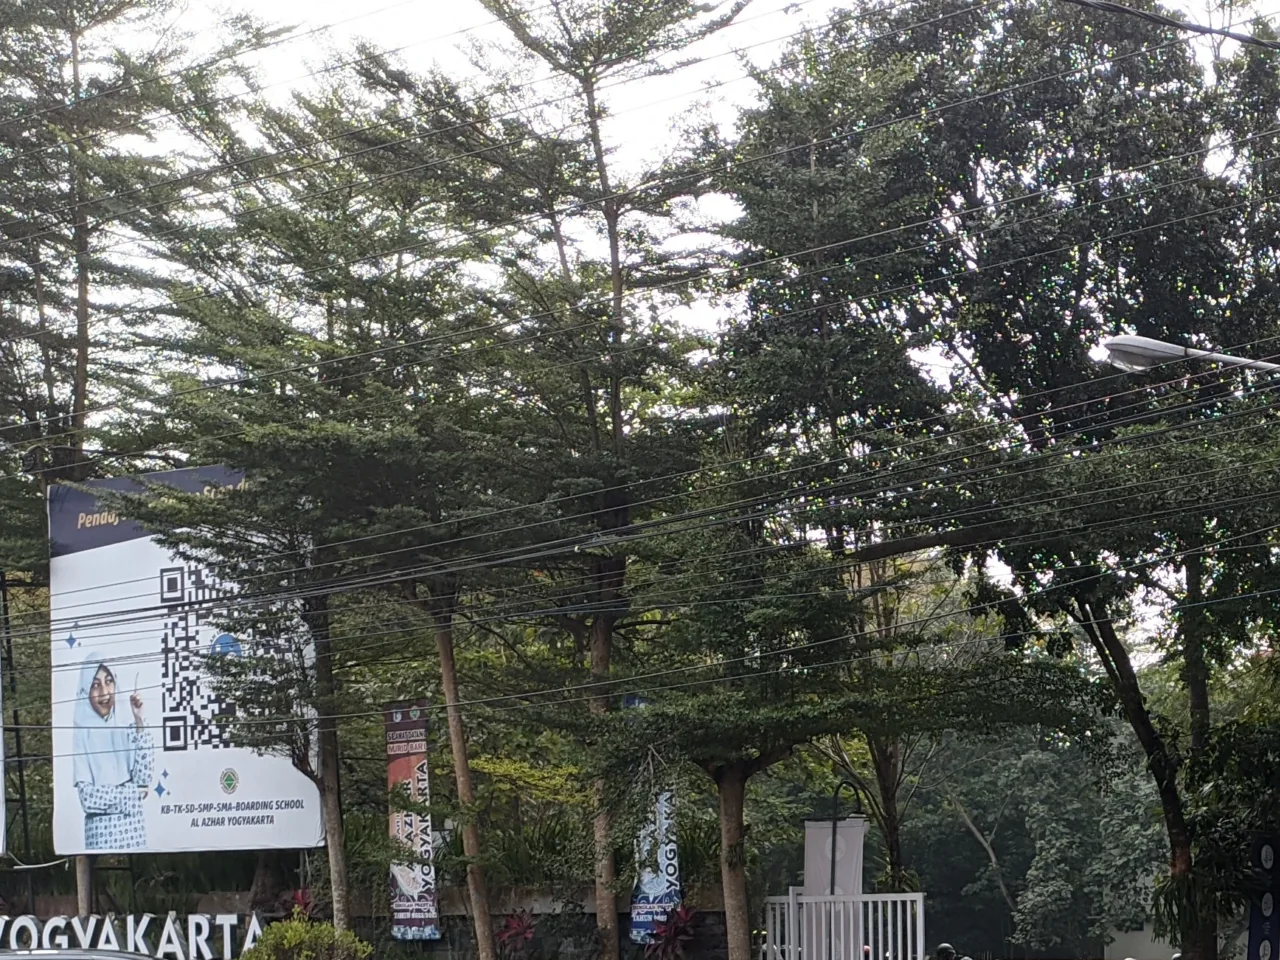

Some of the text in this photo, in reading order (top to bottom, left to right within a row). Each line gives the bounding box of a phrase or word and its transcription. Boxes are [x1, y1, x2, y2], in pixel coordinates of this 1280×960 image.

[160, 799, 305, 815] KB-TK-SD-SMP-SMA-BOARDING SCHOOL
[190, 814, 275, 828] AL AZHAR YOGYAKARTA
